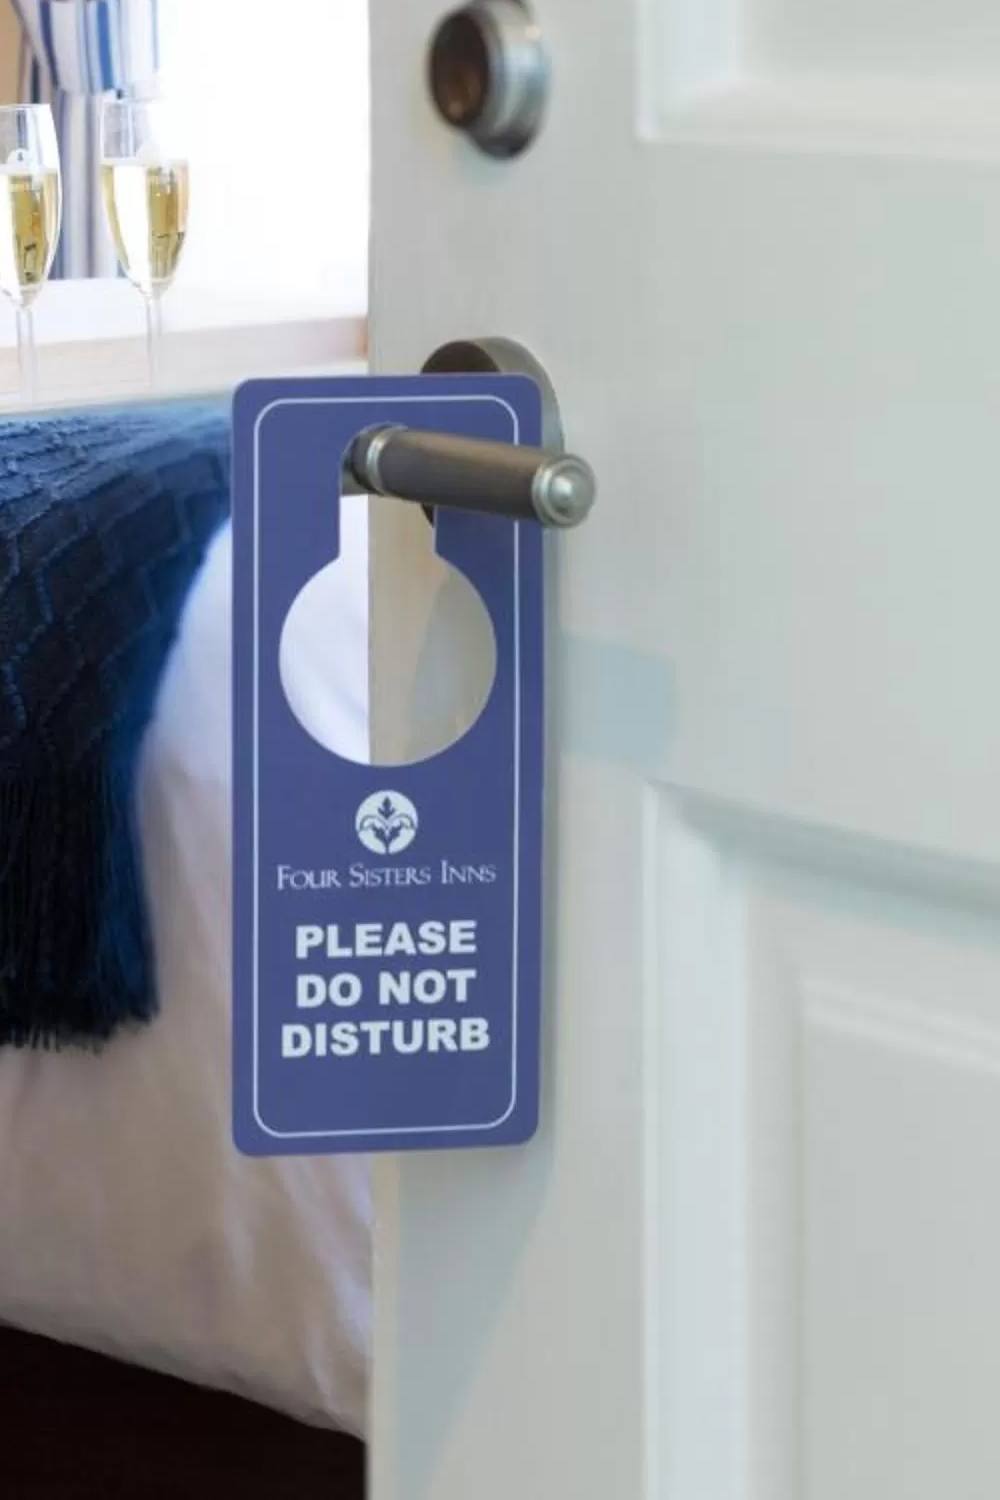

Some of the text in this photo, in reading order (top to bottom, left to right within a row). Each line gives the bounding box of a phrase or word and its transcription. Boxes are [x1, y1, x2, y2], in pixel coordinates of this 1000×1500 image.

[277, 860, 497, 890] FOUR SISTERS INNS
[296, 920, 477, 959] PLEASE
[297, 969, 476, 1008] DO NOT
[282, 1017, 490, 1057] DISTURB
